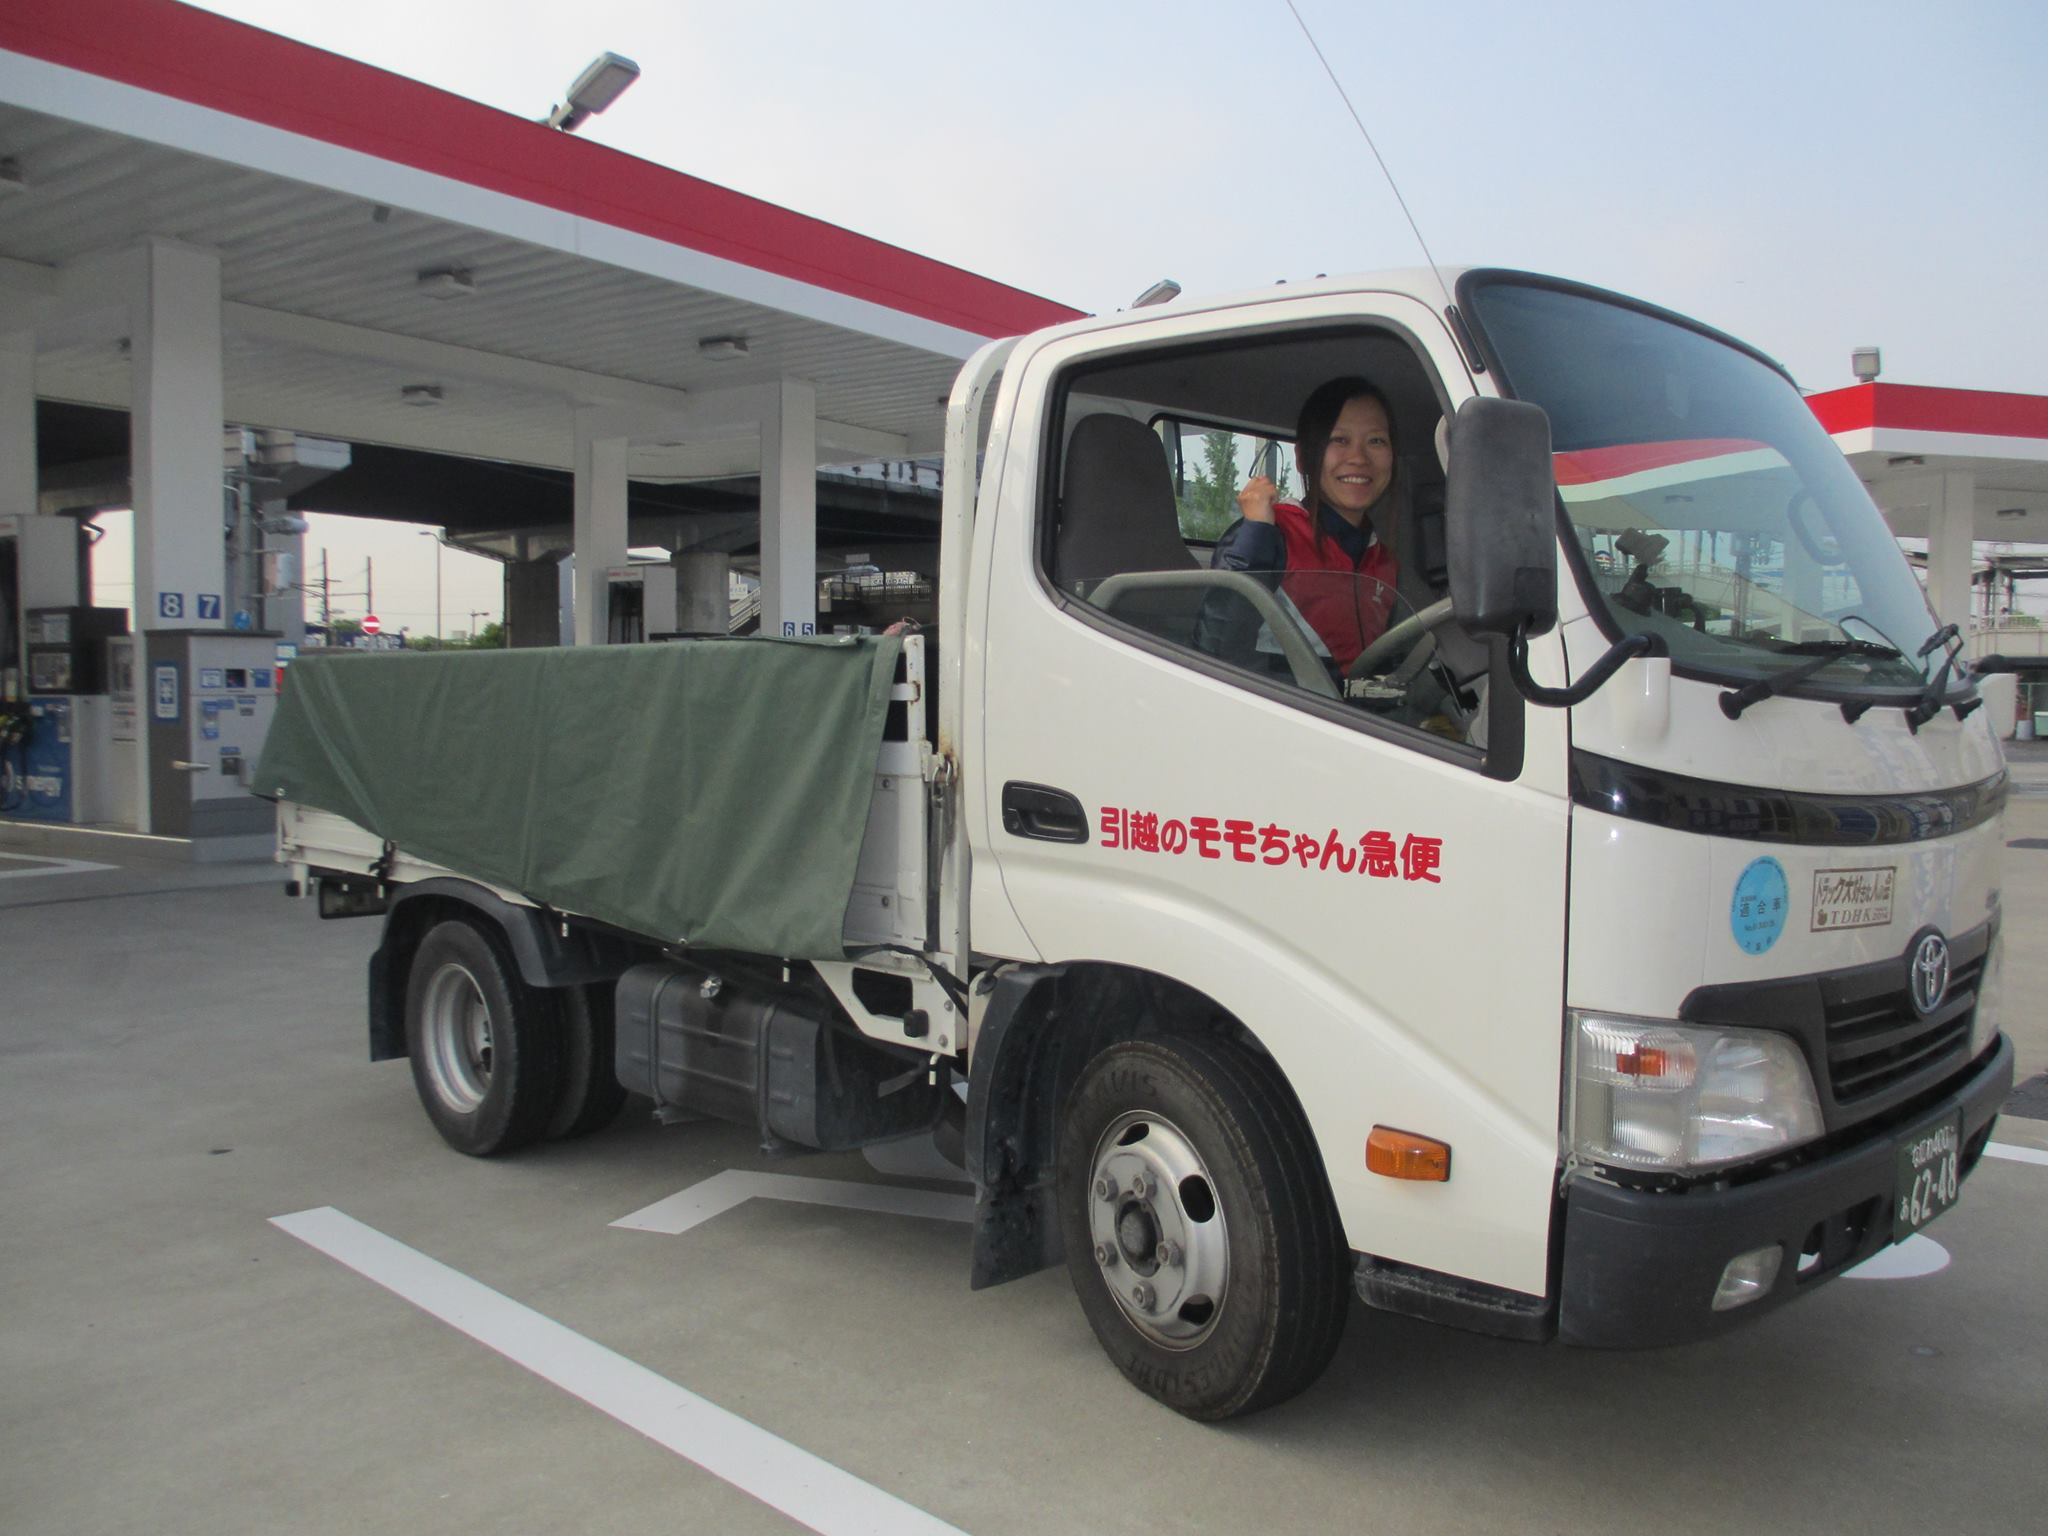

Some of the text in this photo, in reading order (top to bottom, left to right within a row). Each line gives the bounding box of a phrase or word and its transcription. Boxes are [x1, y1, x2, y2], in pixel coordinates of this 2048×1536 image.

[163, 594, 217, 618] 8 7
[785, 623, 812, 637] 6 5
[1100, 806, 1443, 884] 引越のモモちゃん急便
[1911, 1152, 1957, 1226] 62-48
